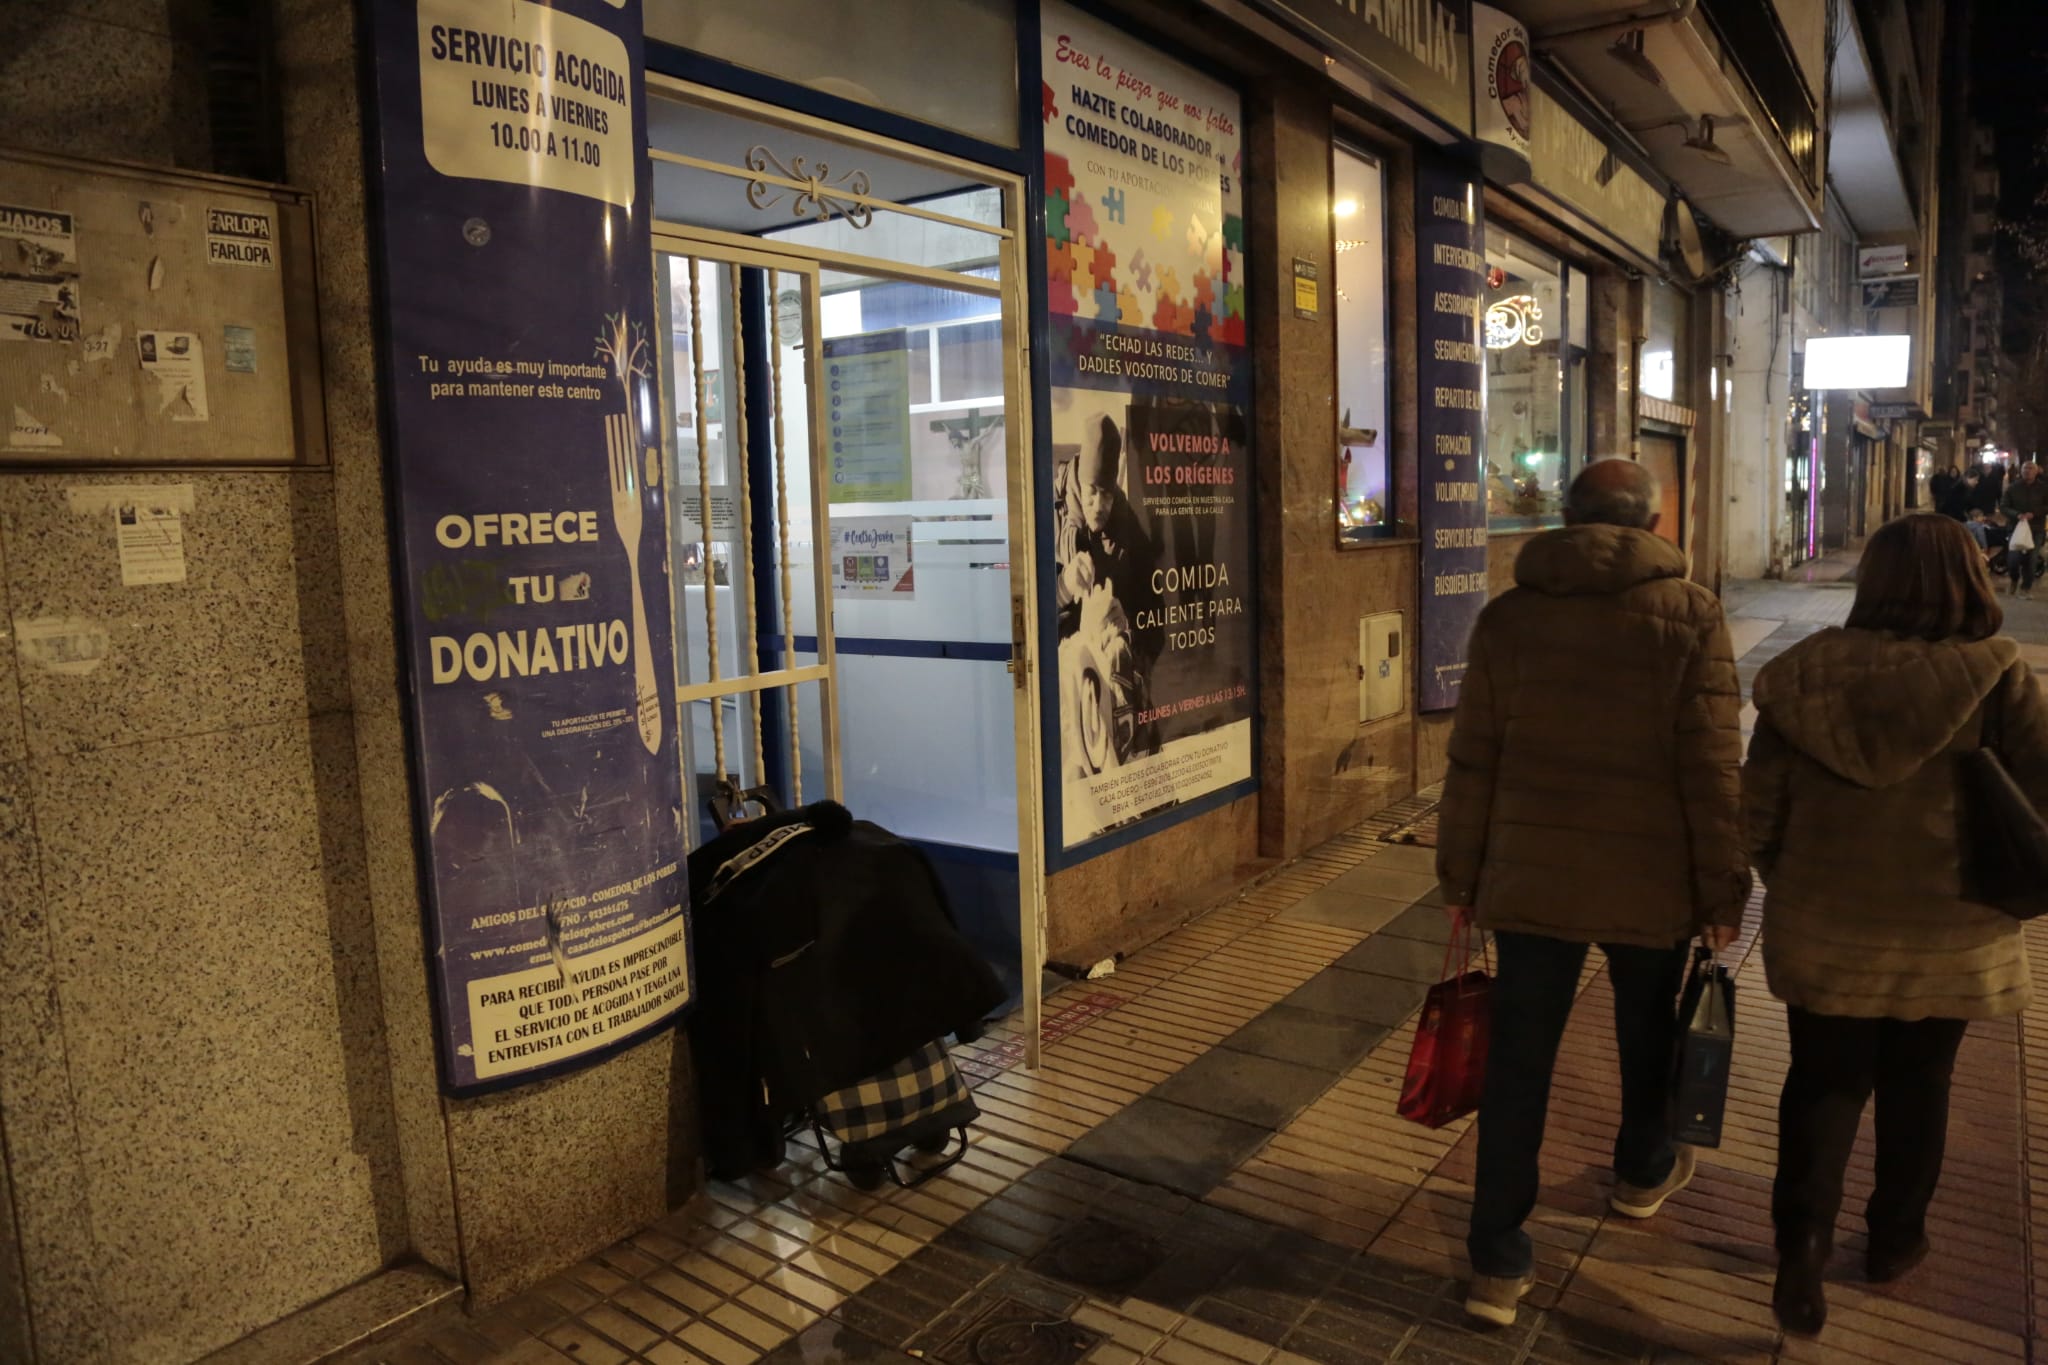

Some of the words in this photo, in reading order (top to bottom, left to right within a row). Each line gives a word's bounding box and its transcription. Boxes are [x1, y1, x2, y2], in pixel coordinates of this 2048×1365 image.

[431, 25, 548, 78] SERVICIO
[554, 51, 627, 106] ACOGIDA
[1487, 28, 1511, 99] Comedor
[1056, 35, 1090, 71] Eres
[1096, 56, 1112, 80] la
[1116, 69, 1152, 100] pieza
[1157, 89, 1179, 113] que
[1184, 104, 1203, 120] nos
[1206, 106, 1235, 136] falta
[472, 80, 530, 113] LUNES
[536, 93, 547, 117] A
[551, 97, 609, 134] VIERNES
[1072, 85, 1116, 120] HAZTE
[1121, 105, 1212, 157] COLABORADOR
[491, 122, 541, 153] 10.00
[547, 132, 557, 156] A
[562, 136, 601, 167] 11.00
[1066, 115, 1137, 158] COMEDOR
[1142, 144, 1158, 166] DE
[1163, 152, 1184, 175] LOS
[1189, 162, 1231, 193] POBES
[1087, 160, 1105, 177] CON
[0, 210, 64, 233] JADOS
[1433, 195, 1459, 219] COMIDA
[208, 211, 270, 238] FARLOPA
[211, 242, 271, 264] FARLOPA
[419, 355, 438, 373] Tu
[447, 357, 492, 376] ayuda
[496, 361, 512, 373] es
[517, 362, 544, 379] muy
[548, 360, 606, 379] importante
[1145, 341, 1163, 357] LAS
[1206, 351, 1213, 365] Y
[1079, 355, 1121, 376] DADLES
[1125, 362, 1178, 382] VOSOTROS
[1181, 368, 1193, 384] DE
[431, 382, 464, 399] para
[468, 383, 534, 397] mantener
[537, 384, 564, 398] este
[567, 384, 601, 400] centro
[1435, 387, 1464, 408] REPARTO
[1149, 433, 1218, 454] VOLVEMOS
[1221, 437, 1230, 455] A
[1146, 466, 1171, 485] LOS
[1174, 462, 1235, 486] ORÍGENES
[435, 511, 599, 549] OFRECE
[1435, 528, 1463, 549] SERVICIO
[1464, 528, 1472, 548] DE
[509, 575, 555, 604] TU
[1151, 562, 1229, 595] COMIDA
[1136, 602, 1203, 630] CALIENTE
[1209, 597, 1242, 617] PARA
[430, 619, 629, 685] DONATIVO
[1169, 626, 1215, 651] TODOS
[1138, 711, 1148, 725] DE
[1149, 704, 1170, 722] LUNES
[1172, 704, 1178, 715] A
[1178, 695, 1205, 712] VIERNES
[1205, 695, 1211, 705] A
[1090, 777, 1119, 796] TAMBIÉN
[1120, 771, 1145, 785] PUEDES
[471, 911, 517, 930] AMIGOS
[518, 906, 539, 922] DEL
[592, 882, 632, 903] COMEDOR
[632, 877, 644, 893] DE
[480, 989, 515, 1008] PARA
[572, 963, 606, 986] AYUDA
[609, 959, 620, 975] ES
[623, 929, 683, 967] IMPRESCINDIBLE
[519, 1002, 544, 1020] QUE
[582, 976, 629, 1001] PERSONA
[630, 966, 651, 985] PASE
[652, 956, 668, 973] POR
[494, 1029, 511, 1044] EL
[514, 1014, 570, 1039] SERVICIO
[574, 1008, 589, 1023] DE
[592, 989, 634, 1016] ACOGIDA
[635, 986, 642, 1000] Y
[643, 975, 668, 996] TENGA
[668, 965, 681, 983] UNA
[488, 1034, 563, 1064] ENTREVISTA
[566, 1025, 589, 1046] CON
[592, 1021, 605, 1036] EL
[608, 993, 662, 1031] TRABAJADOR
[663, 981, 686, 1004] SOCIAL
